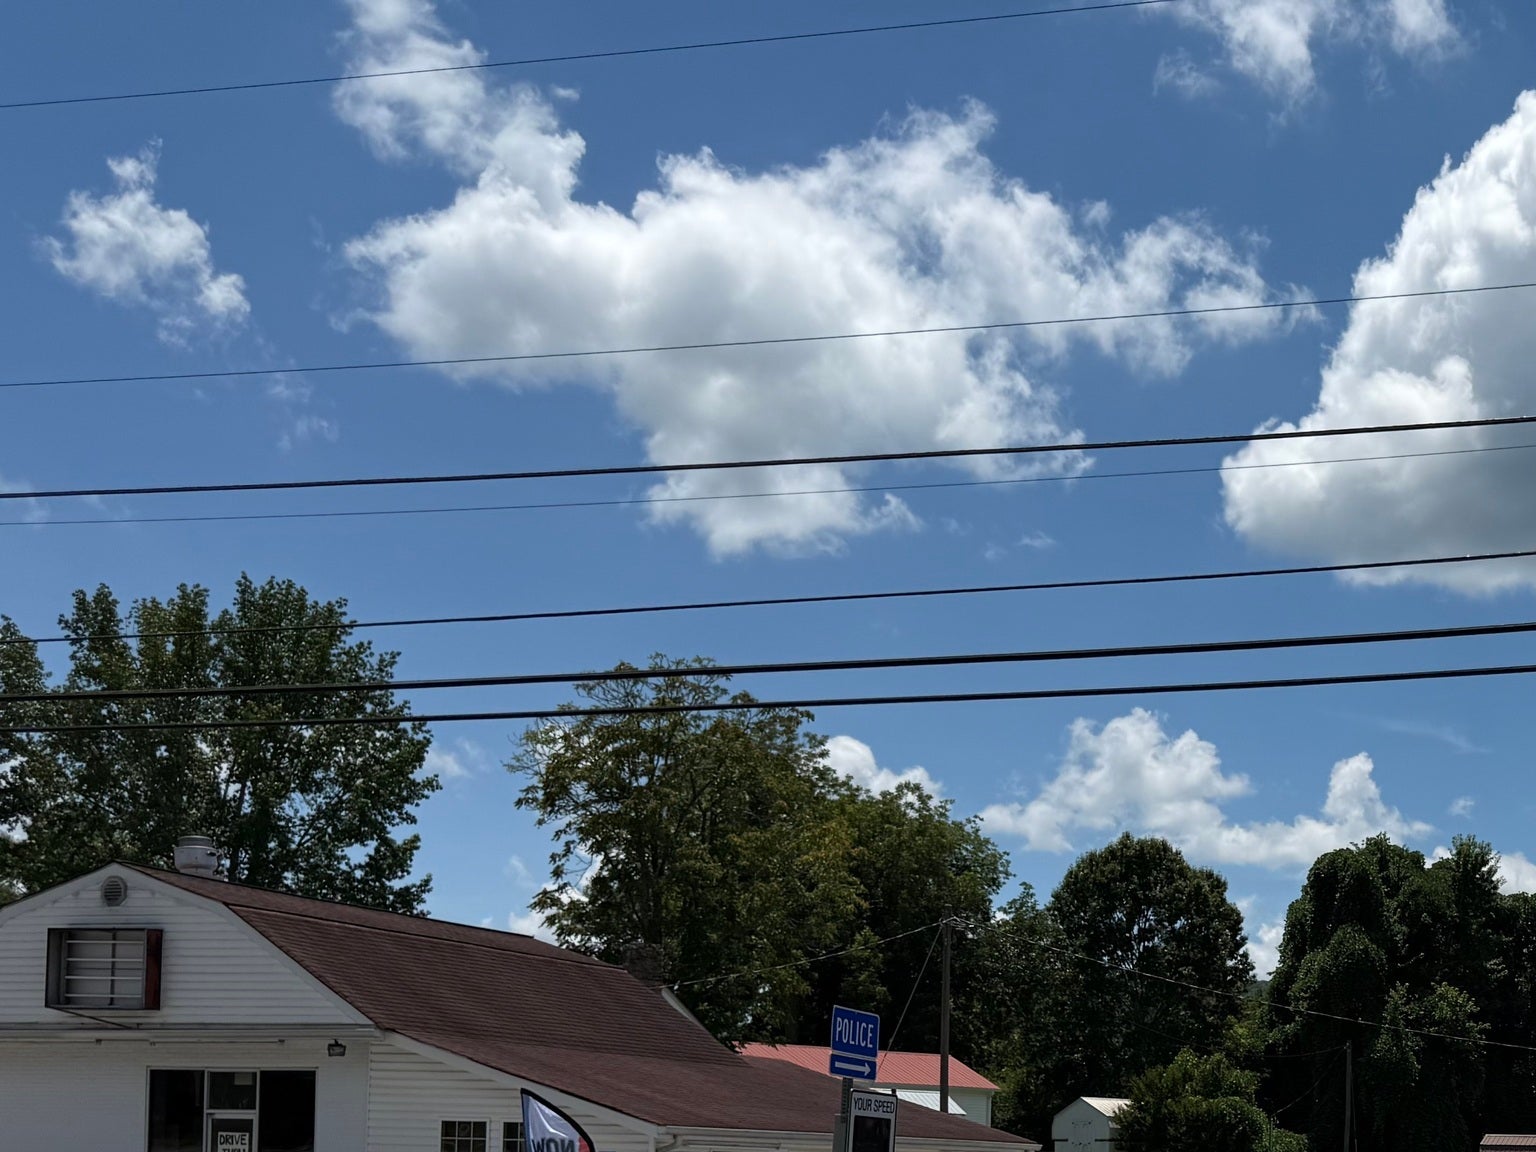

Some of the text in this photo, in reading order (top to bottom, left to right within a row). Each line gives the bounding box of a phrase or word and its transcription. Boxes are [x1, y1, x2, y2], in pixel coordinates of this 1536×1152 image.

[835, 1016, 875, 1048] POLICE
[853, 1097, 895, 1114] YOUR SPEED
[219, 1134, 247, 1146] DRIVE
